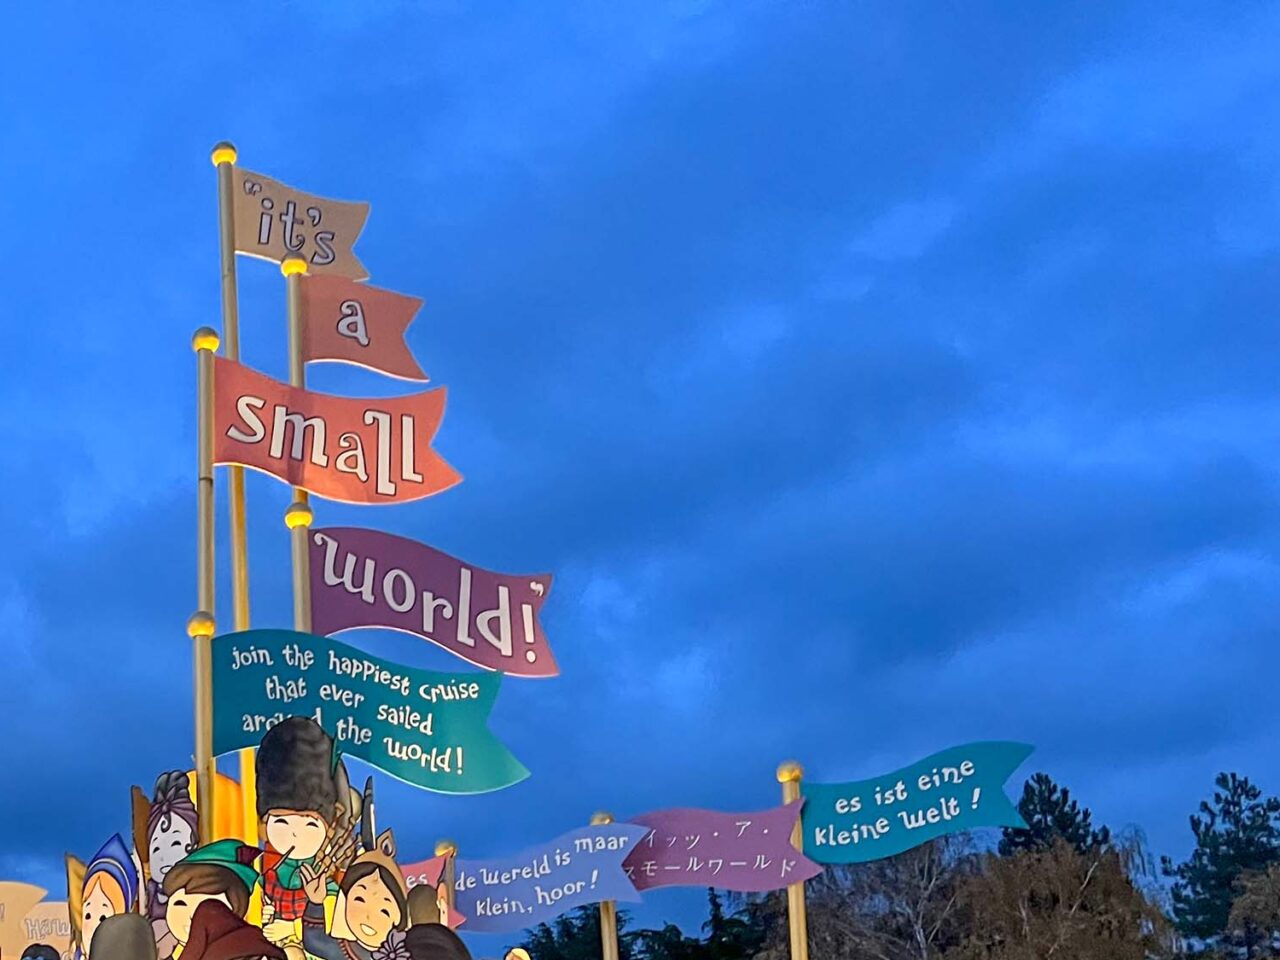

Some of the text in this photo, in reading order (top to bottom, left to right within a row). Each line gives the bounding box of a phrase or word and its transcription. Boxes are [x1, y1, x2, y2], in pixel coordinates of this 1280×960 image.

[336, 300, 370, 348] a
[225, 394, 424, 497] small
[231, 643, 480, 703] join the happiest cruise
[265, 675, 433, 736] that ever sailed
[336, 716, 373, 746] the
[383, 737, 463, 776] world!
[835, 760, 976, 815] es ist eine
[454, 835, 628, 892] de wereld is maar
